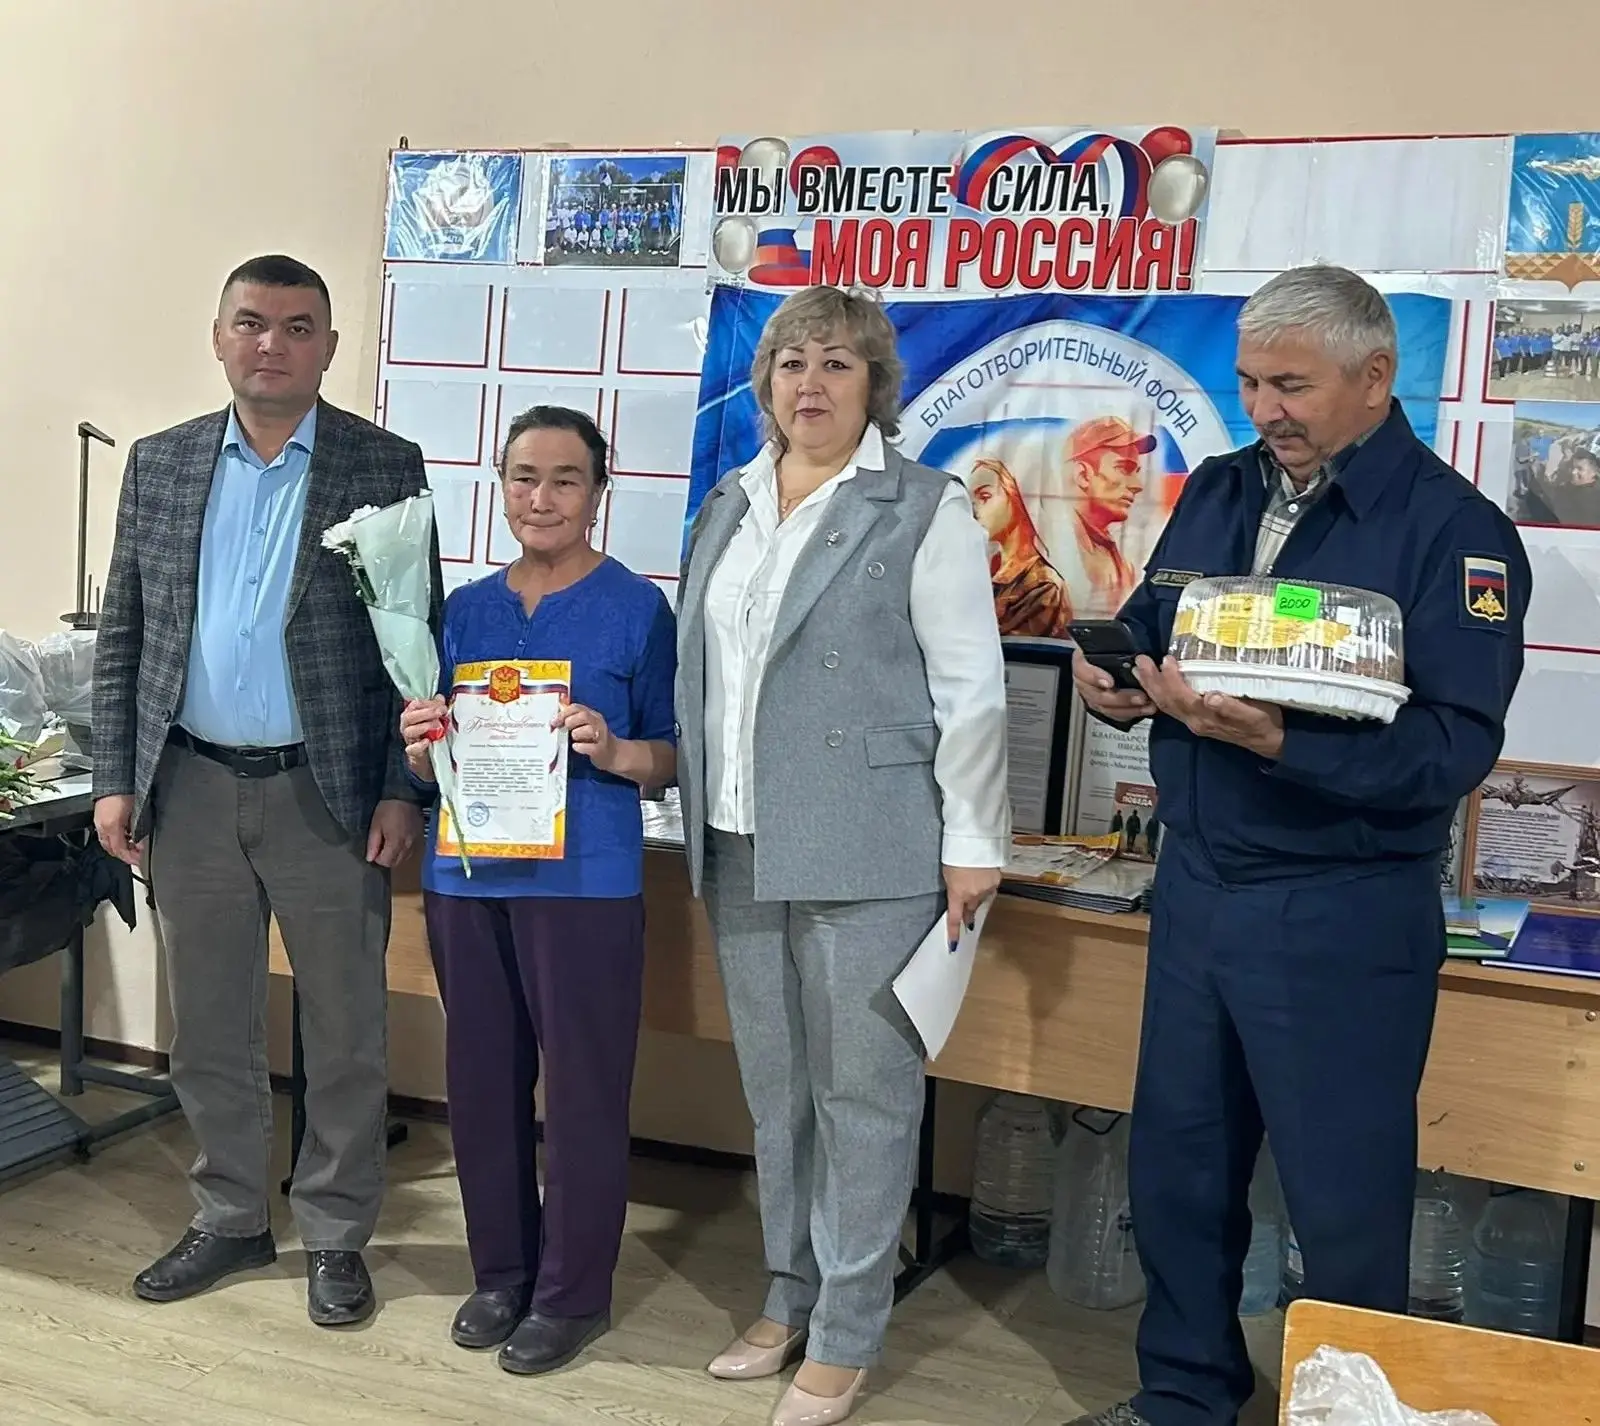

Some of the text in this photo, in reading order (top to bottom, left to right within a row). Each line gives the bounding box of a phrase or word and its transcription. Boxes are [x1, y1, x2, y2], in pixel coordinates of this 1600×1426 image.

[714, 162, 1110, 218] МЫ ВМЕСТЕ СИЛА,
[809, 216, 1197, 291] МОЯ РОССИЯ!
[920, 337, 1199, 438] БЛАГОТВОРИТЕЛЬНЫЙ ФОНД
[1279, 596, 1311, 609] 2000
